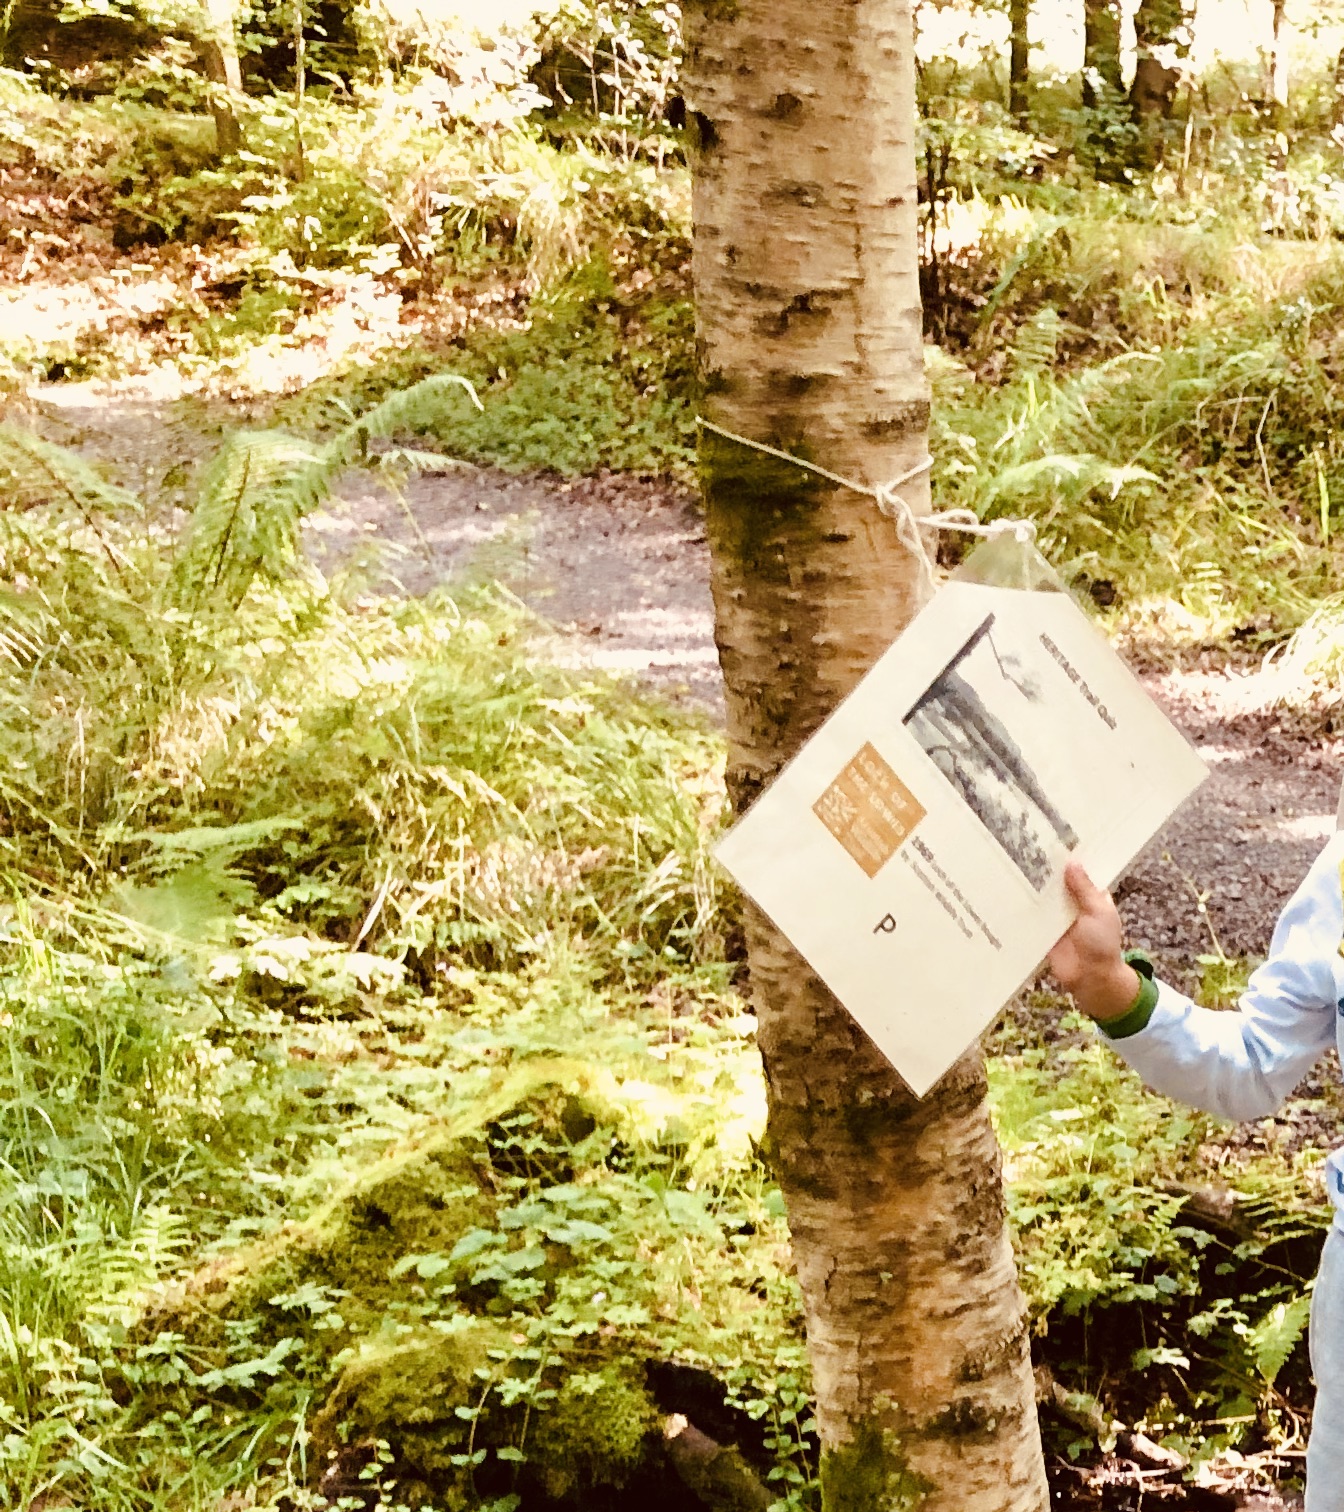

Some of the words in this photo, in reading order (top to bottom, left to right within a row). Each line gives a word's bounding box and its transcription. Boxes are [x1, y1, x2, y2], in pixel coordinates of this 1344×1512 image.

[1039, 633, 1080, 683] HERITAGE
[1080, 681, 1099, 706] Trail
[1097, 705, 1116, 729] Quiz
[873, 913, 895, 933] P
